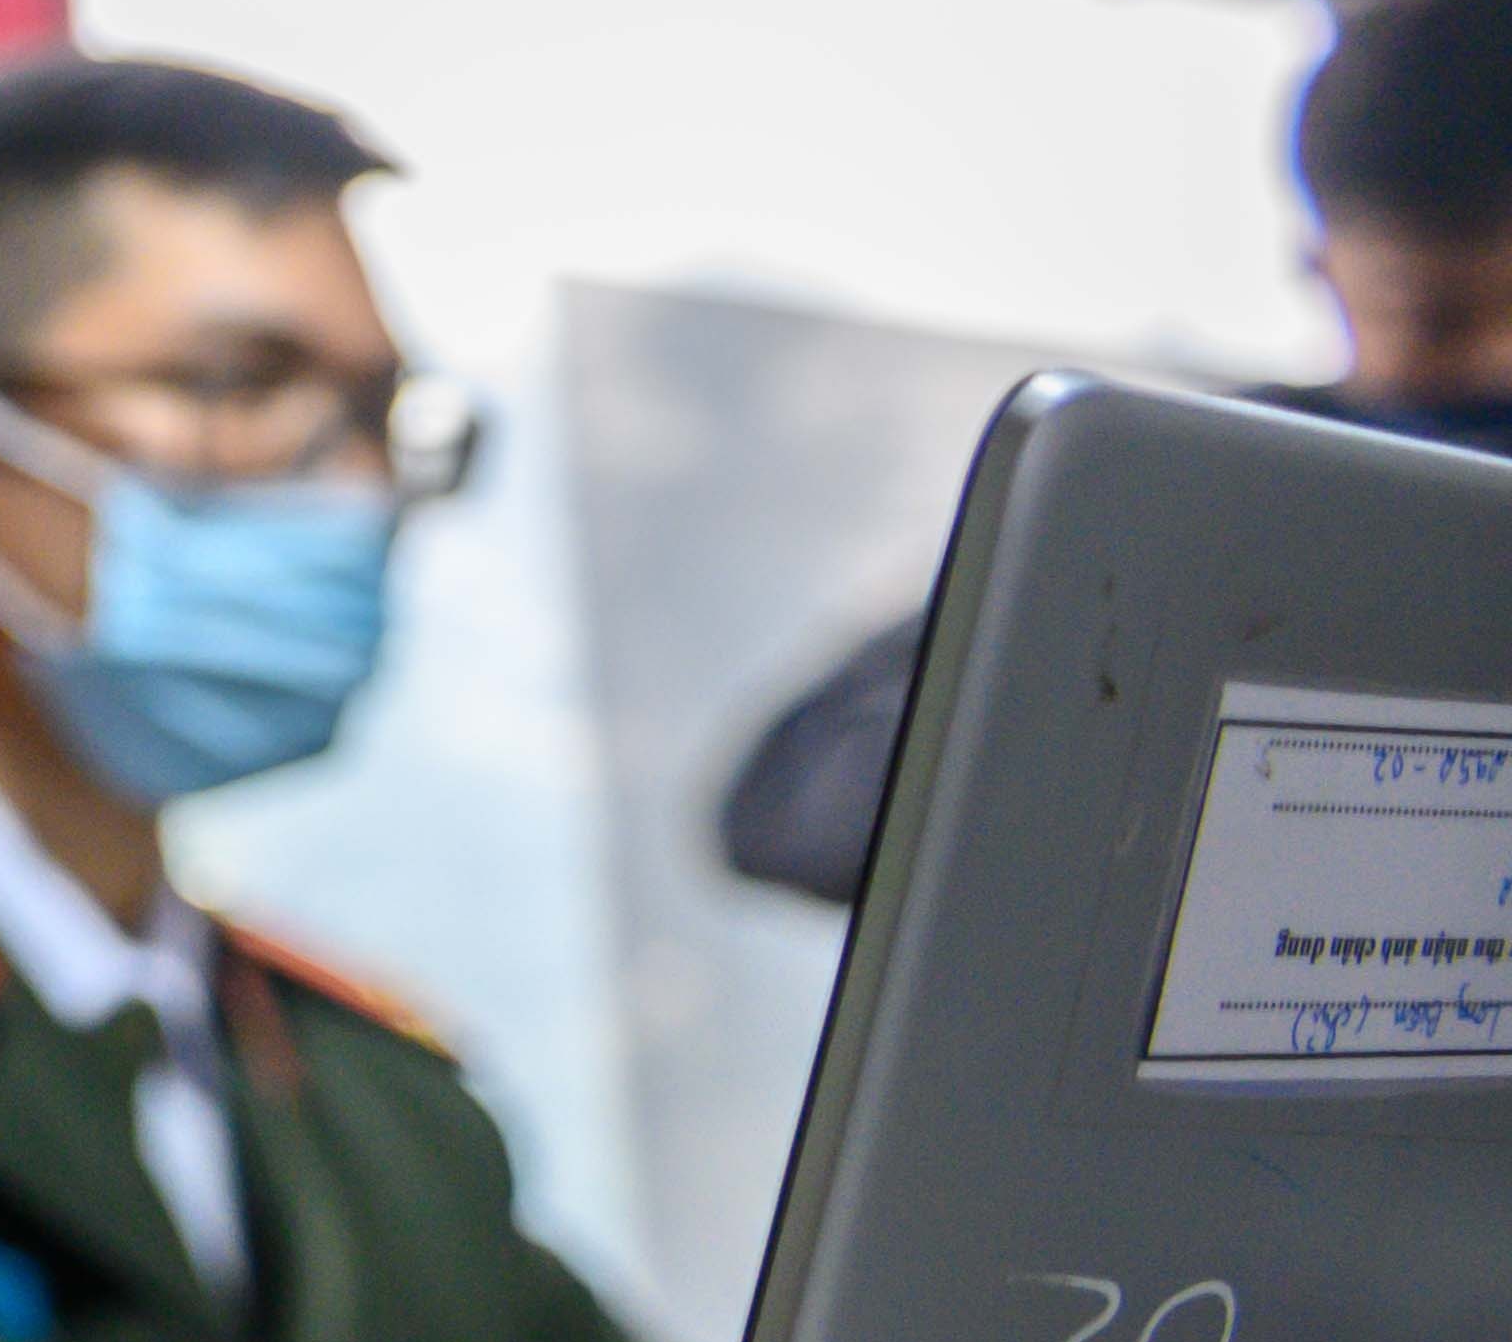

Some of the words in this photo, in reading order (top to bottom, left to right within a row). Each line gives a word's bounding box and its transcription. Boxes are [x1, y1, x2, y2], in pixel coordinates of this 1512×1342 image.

[1275, 927, 1326, 966] dung
[1422, 930, 1468, 966] nhận
[1473, 935, 1506, 964] thu
